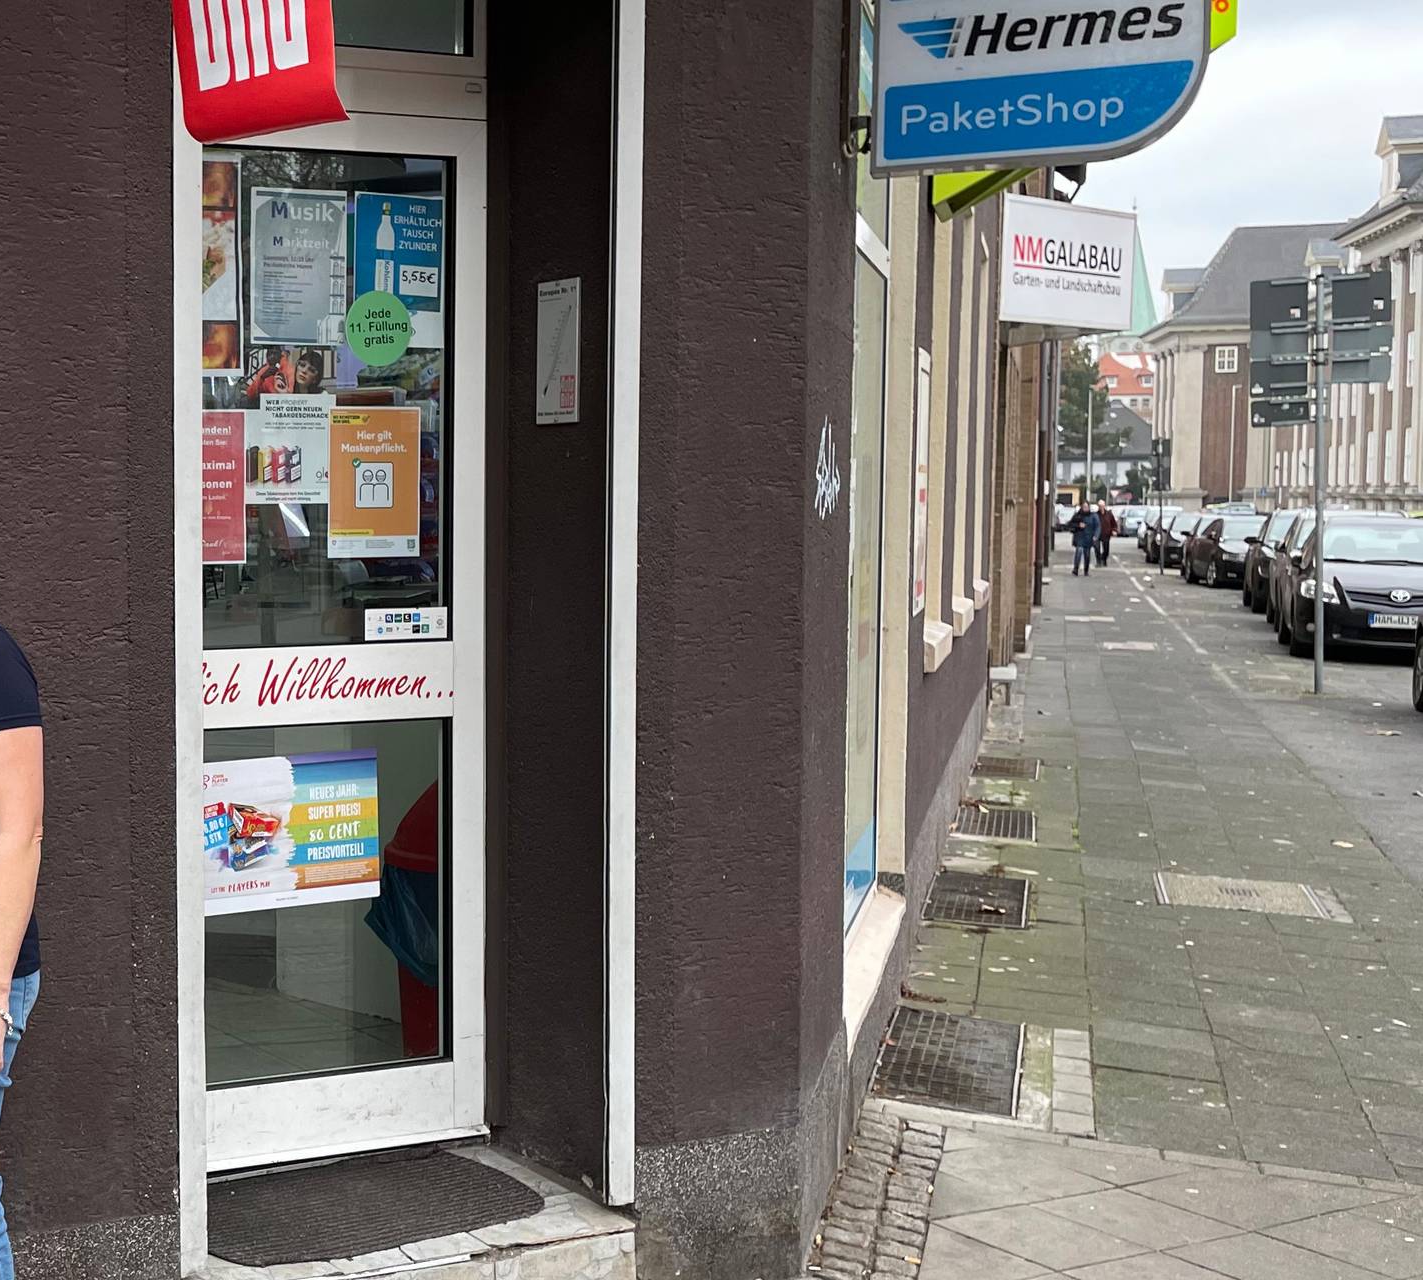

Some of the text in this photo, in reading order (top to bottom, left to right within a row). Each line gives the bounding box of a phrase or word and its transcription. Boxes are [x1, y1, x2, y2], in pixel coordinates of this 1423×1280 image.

[964, 2, 1185, 57] Hermes
[900, 93, 1124, 136] PaketShop
[271, 201, 335, 222] Musik
[409, 205, 426, 215] HIER
[394, 215, 442, 228] ERHÄLTLICH
[402, 228, 434, 240] TAUSCH
[273, 236, 330, 249] Marktzeit
[398, 240, 438, 252] ZYLINDER
[1013, 234, 1122, 272] NMGALABAU
[401, 269, 436, 284] 5,55€
[1013, 272, 1122, 297] Garten- und Landschaftsbau
[365, 308, 391, 320] Jede
[349, 321, 408, 334] 11. Füllung
[364, 334, 395, 348] gratis
[356, 430, 393, 444] Hier gilt
[341, 443, 407, 455] Maskenpflicht.
[258, 656, 454, 707] Willkommen...
[309, 783, 360, 800] NEUES JAHR:
[308, 805, 334, 820] SUPER
[329, 821, 361, 840] CENT
[228, 880, 258, 893] PLAYERS
